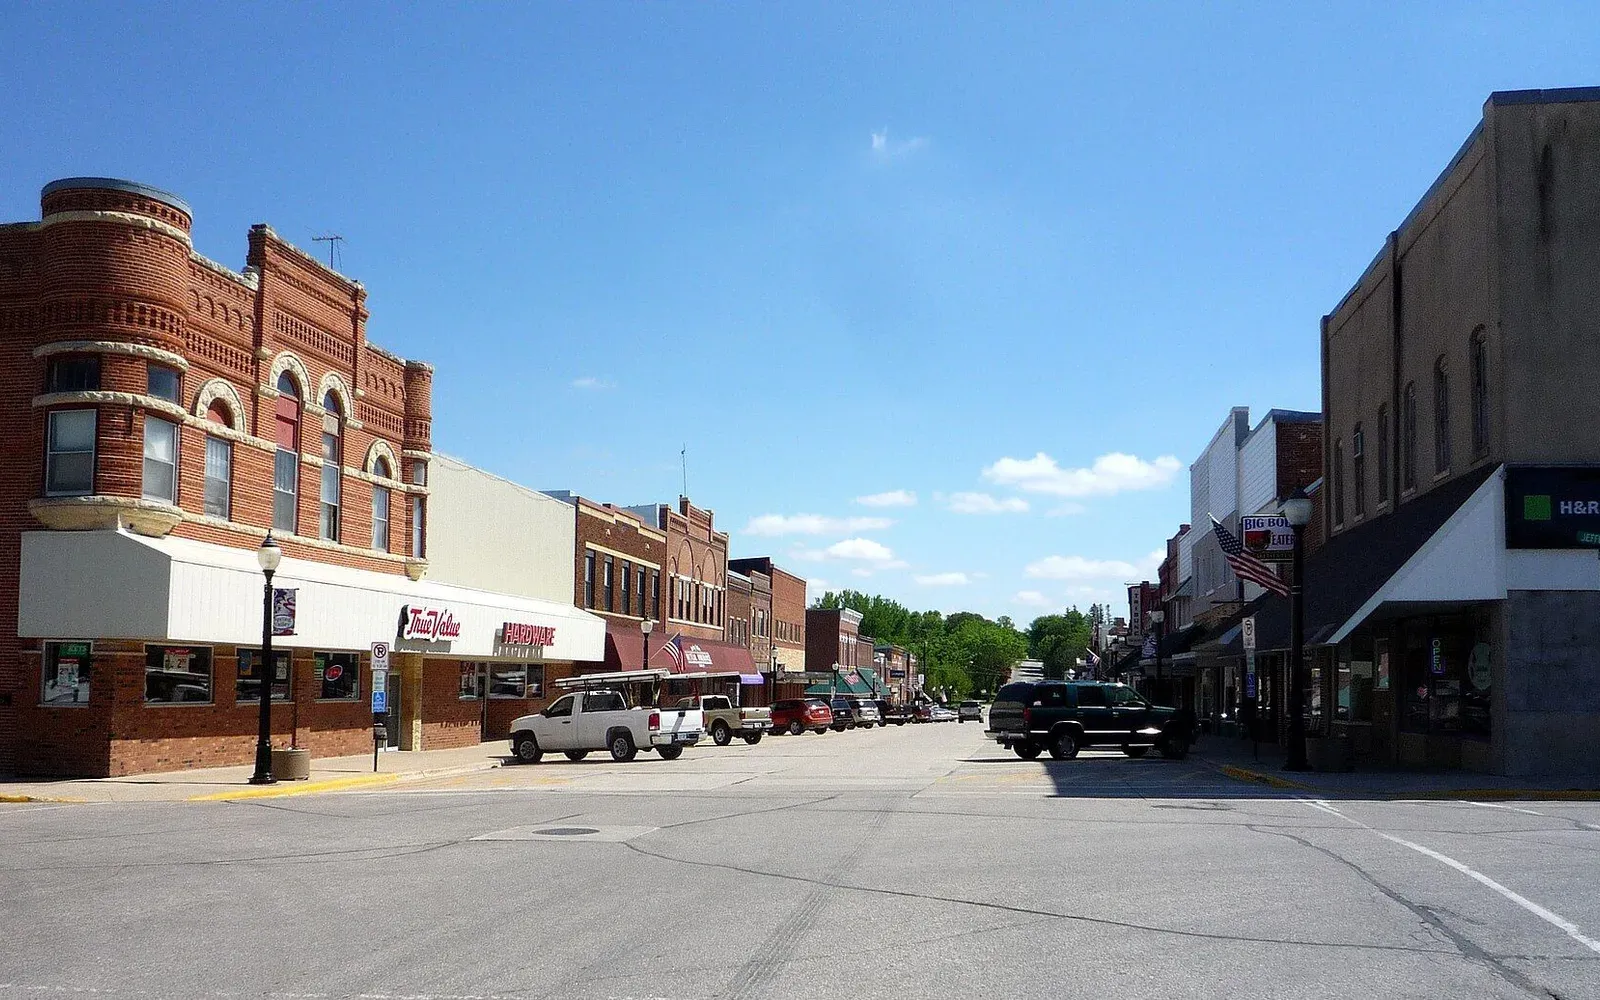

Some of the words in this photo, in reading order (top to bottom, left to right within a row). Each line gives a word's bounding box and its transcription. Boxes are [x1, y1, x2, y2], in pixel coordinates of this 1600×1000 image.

[1560, 501, 1600, 514] H&R
[1245, 518, 1264, 530] BIG
[407, 608, 432, 634] True
[427, 610, 461, 638] Value
[503, 622, 556, 647] HARDWARE
[1432, 639, 1442, 671] OPEN
